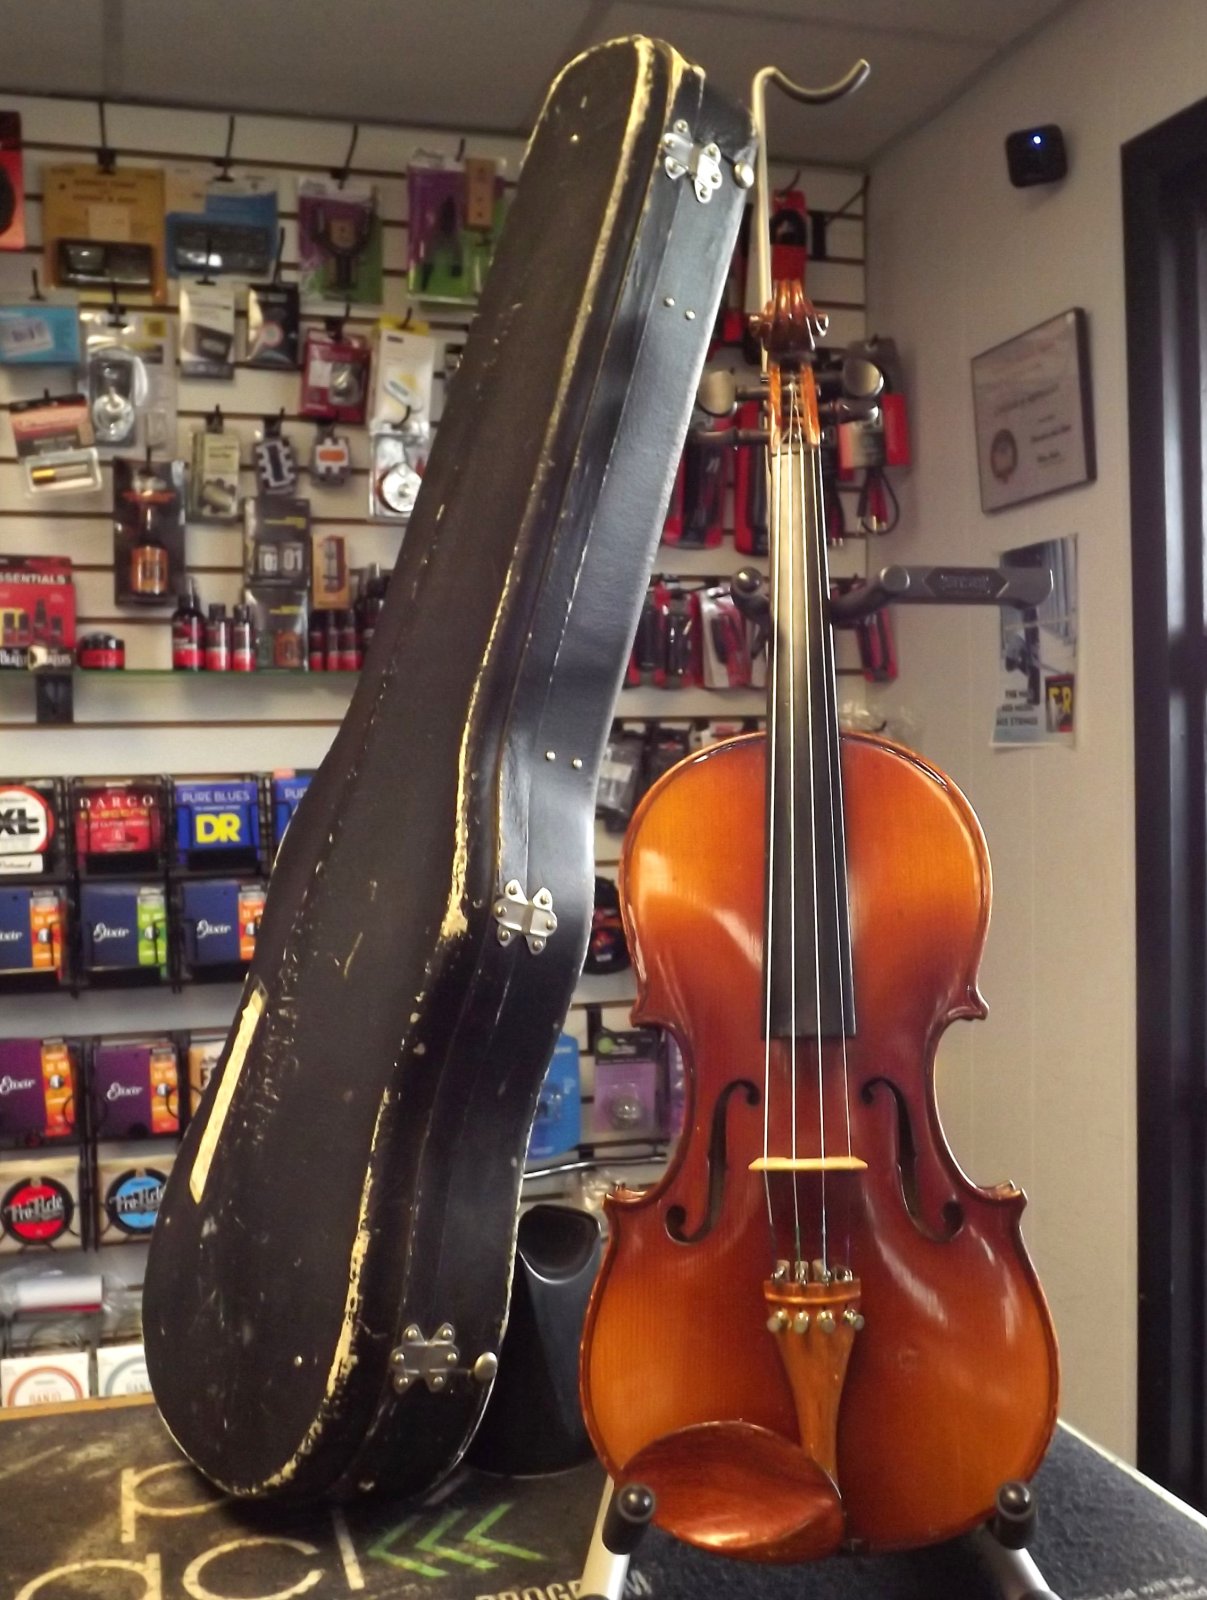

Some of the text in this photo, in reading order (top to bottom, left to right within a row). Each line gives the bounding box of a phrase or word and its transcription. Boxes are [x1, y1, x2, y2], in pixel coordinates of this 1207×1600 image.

[80, 795, 154, 810] DARCO
[182, 790, 250, 802] PURE BLUES
[195, 812, 241, 843] DR
[93, 921, 130, 943] Elixir
[196, 919, 232, 940] Elixir
[106, 1081, 143, 1101] Elixir
